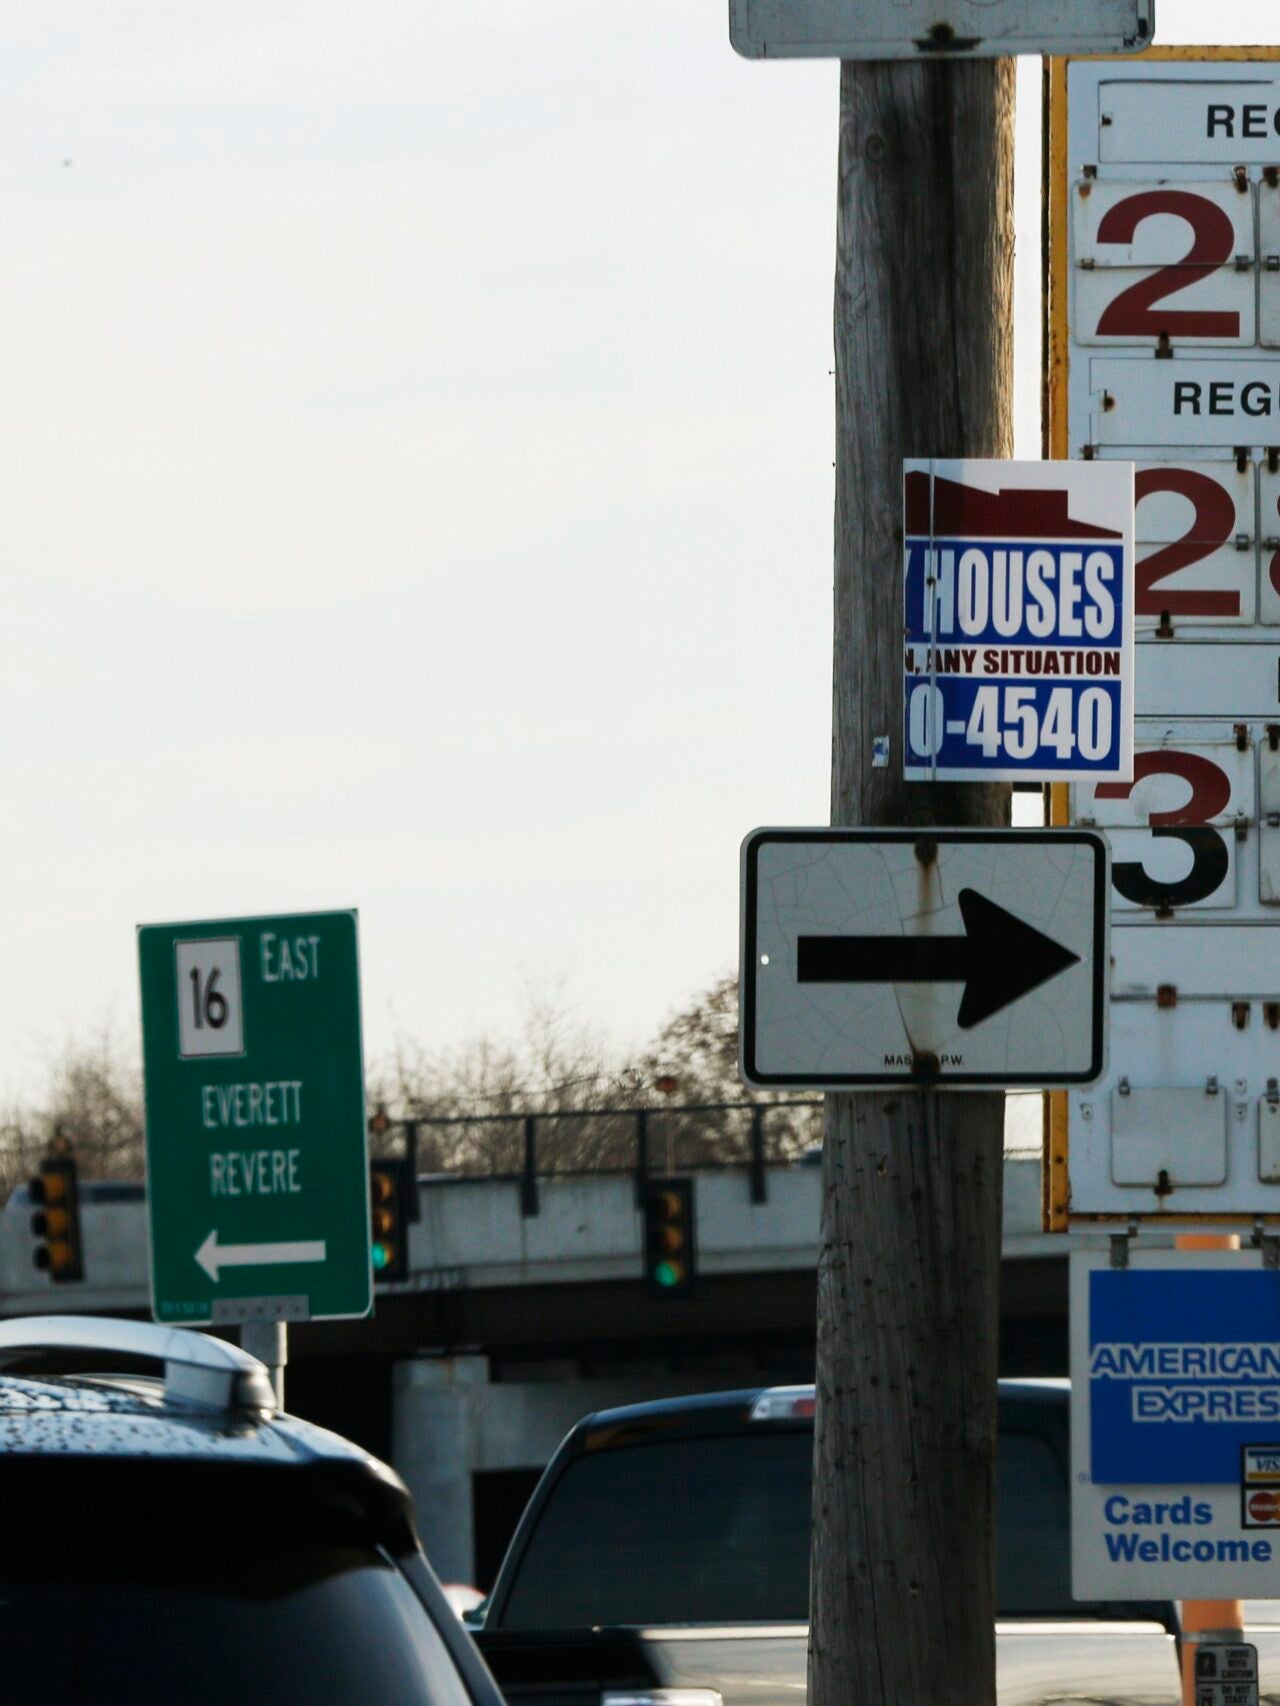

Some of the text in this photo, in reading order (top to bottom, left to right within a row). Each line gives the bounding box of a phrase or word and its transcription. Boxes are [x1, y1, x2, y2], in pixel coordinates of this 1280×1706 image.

[923, 548, 1115, 639] HOUSES
[926, 648, 978, 673] ANY
[983, 650, 1121, 675] SITUATION
[907, 683, 1113, 761] 0-4540
[260, 932, 321, 982] EAST
[189, 965, 229, 1030] 16
[884, 1054, 912, 1066] MAS
[202, 1081, 303, 1128] EVERETT
[209, 1149, 302, 1197] REVERE
[1104, 1496, 1213, 1525] Cards
[1104, 1533, 1273, 1563] Welcome
